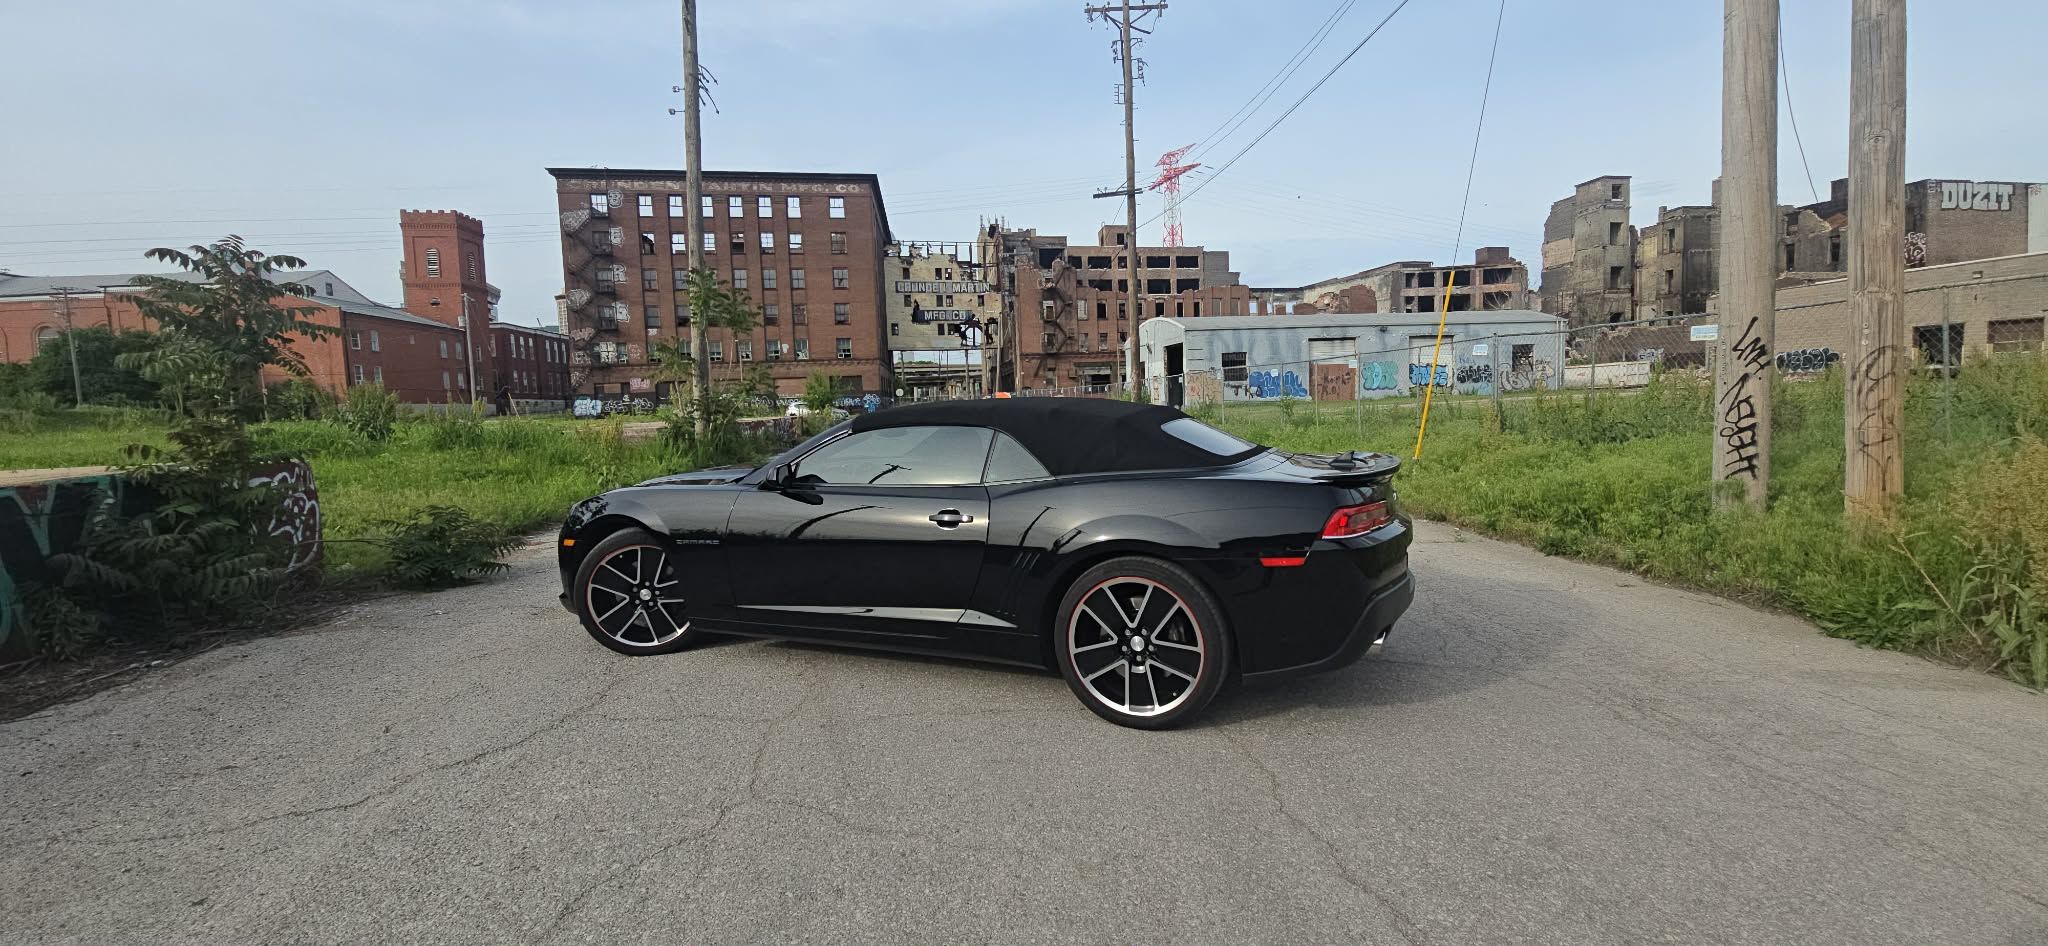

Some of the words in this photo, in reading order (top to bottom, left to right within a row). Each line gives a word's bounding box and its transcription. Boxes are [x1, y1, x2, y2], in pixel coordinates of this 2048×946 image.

[1941, 182, 2014, 211] DUZIT
[952, 282, 990, 293] MARTIN
[924, 310, 946, 321] MFG
